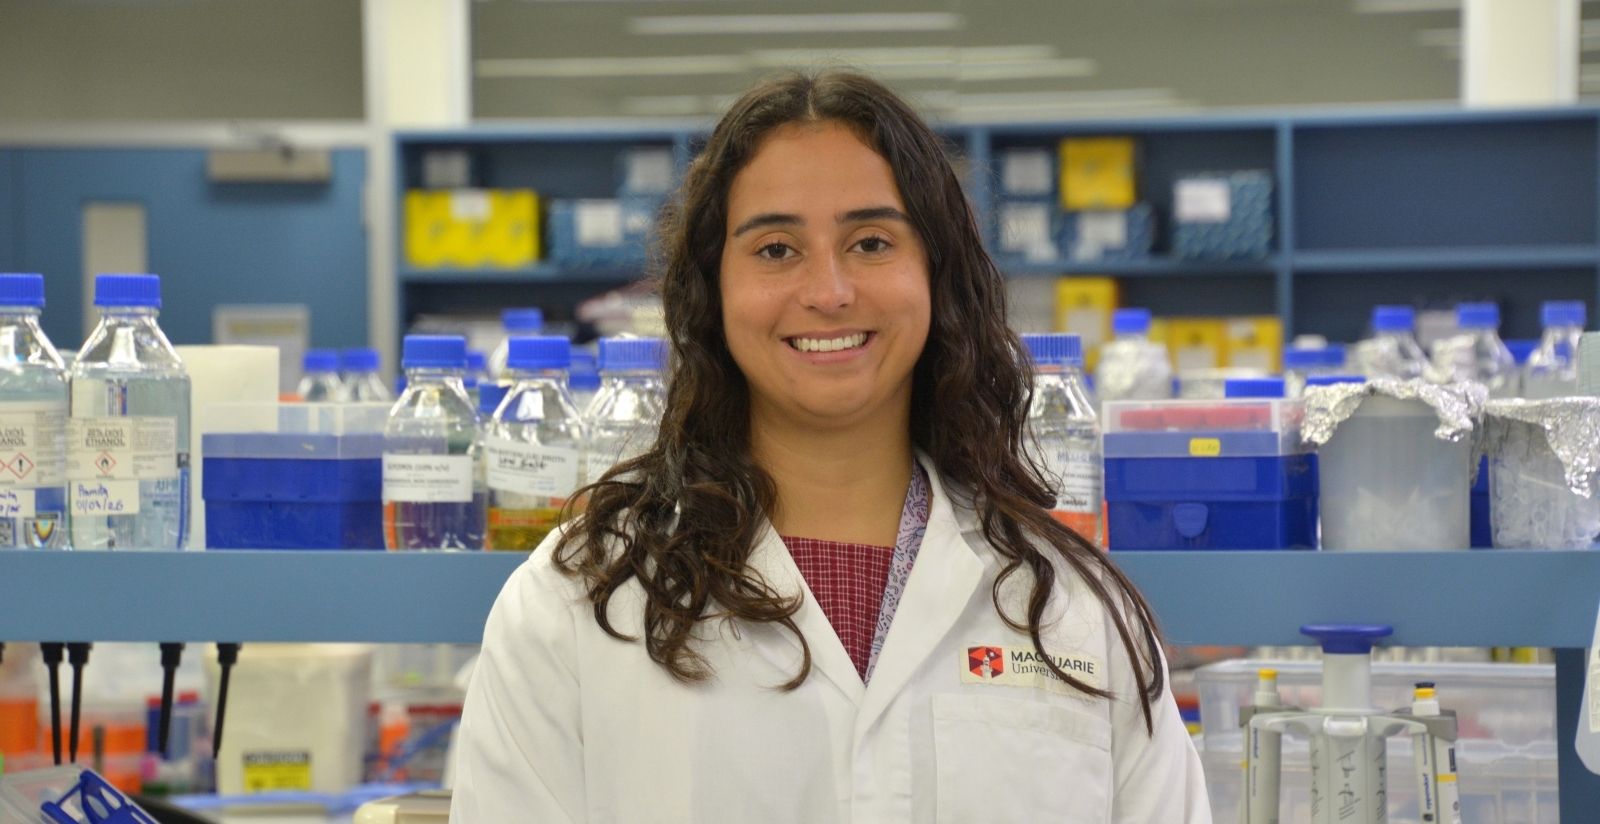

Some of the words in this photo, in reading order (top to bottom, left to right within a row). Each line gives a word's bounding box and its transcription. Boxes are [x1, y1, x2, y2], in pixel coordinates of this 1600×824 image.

[0, 438, 27, 446] ANOL
[85, 438, 126, 448] ETHANOL
[1012, 663, 1071, 684] Univers
